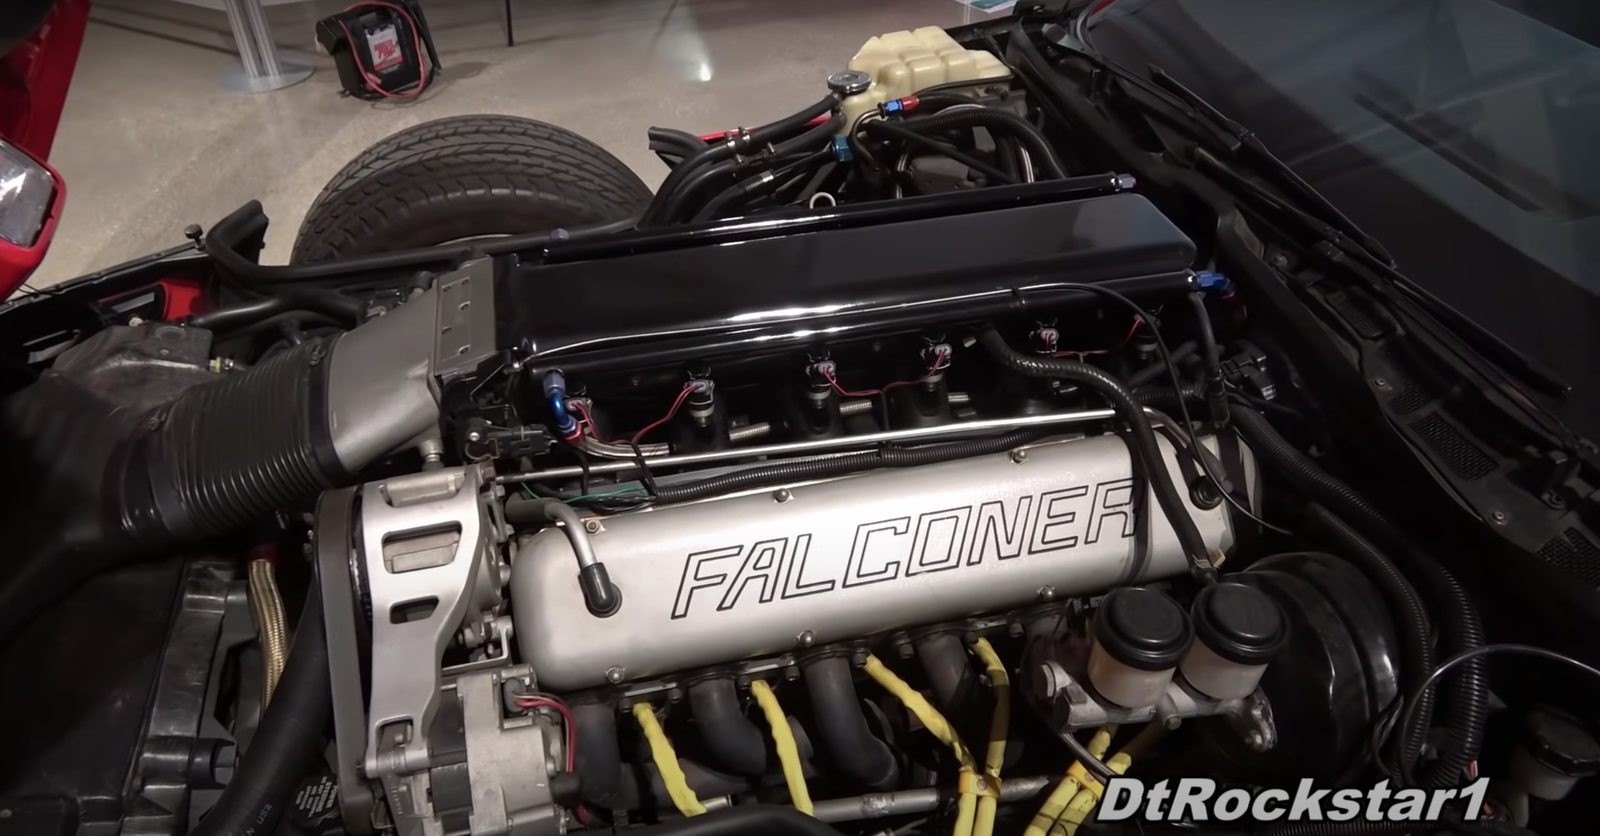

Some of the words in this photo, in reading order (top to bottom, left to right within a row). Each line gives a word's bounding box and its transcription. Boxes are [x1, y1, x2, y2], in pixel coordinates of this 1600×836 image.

[671, 477, 1145, 620] FALCONER
[316, 782, 332, 812] STEERING
[326, 785, 338, 808] POWER
